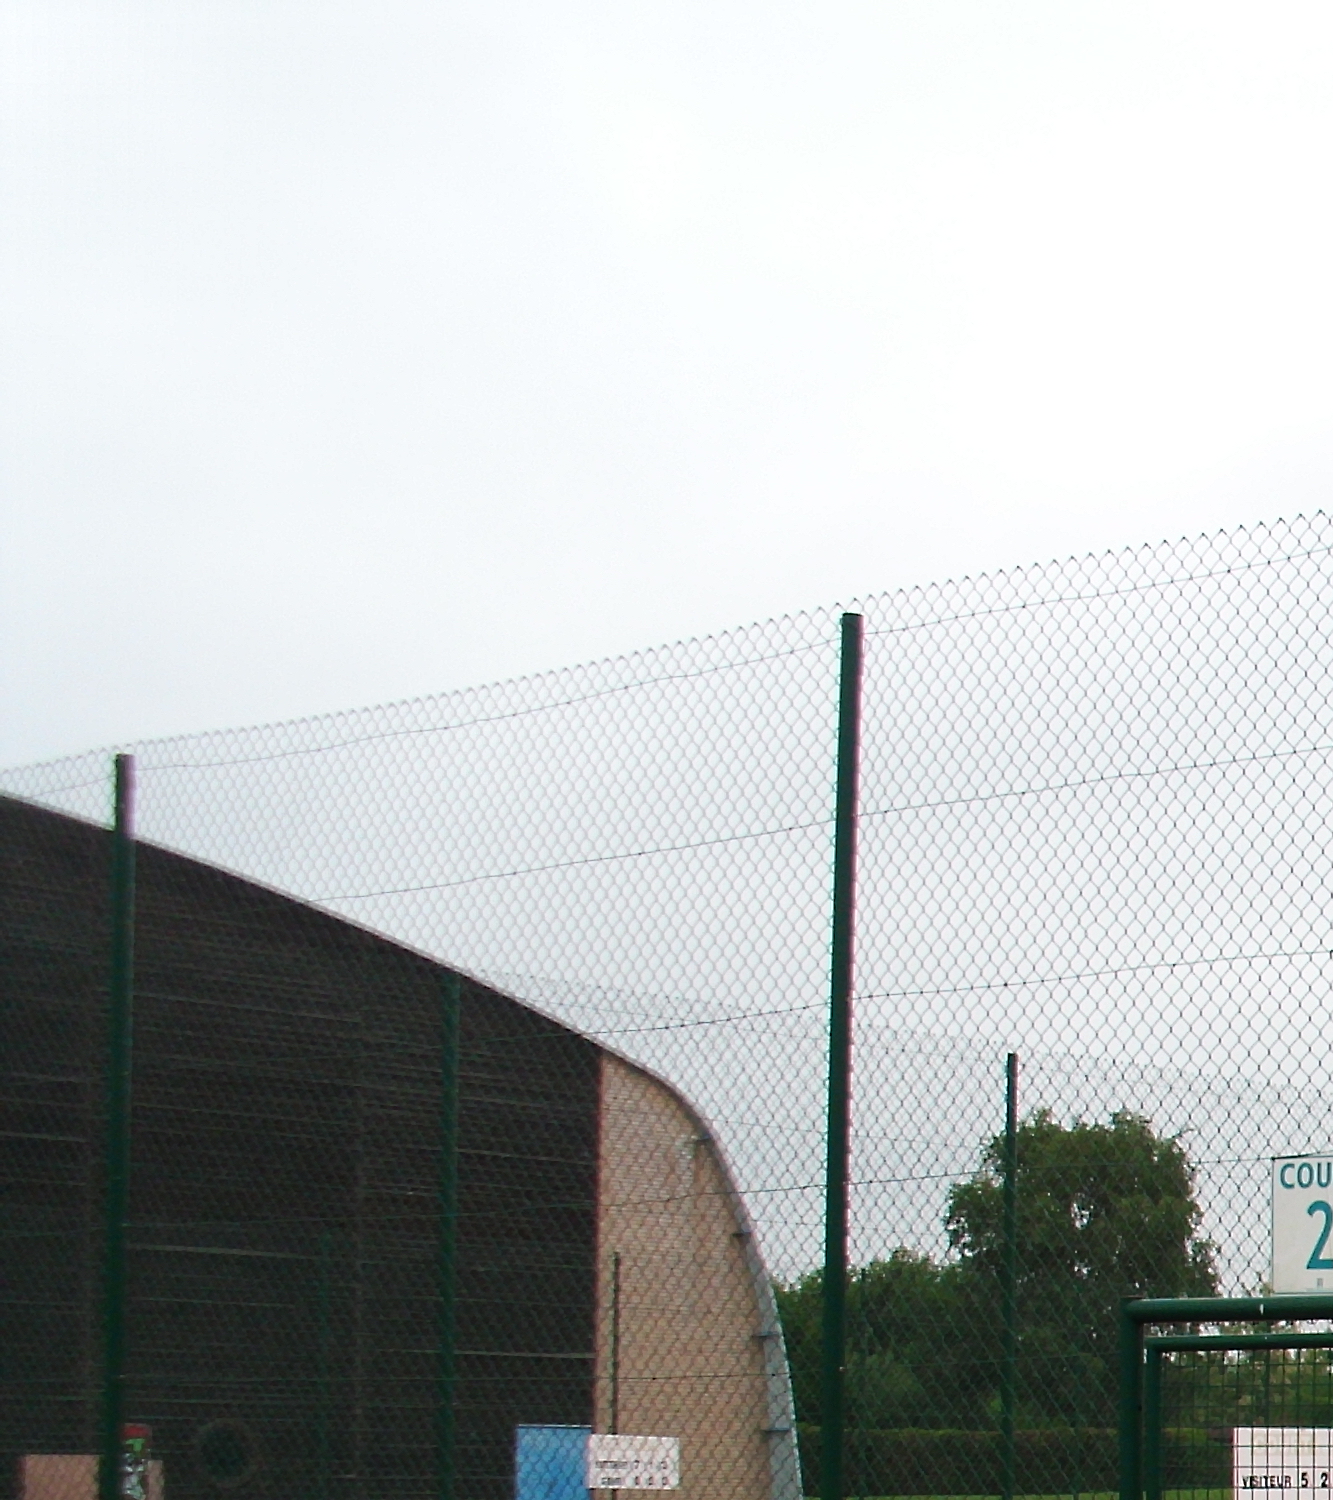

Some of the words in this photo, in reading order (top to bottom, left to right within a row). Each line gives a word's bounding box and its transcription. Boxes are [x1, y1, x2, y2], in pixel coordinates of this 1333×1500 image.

[1242, 1475, 1292, 1489] VISITEUR
[1301, 1472, 1309, 1488] 5
[1320, 1473, 1328, 1488] 2
